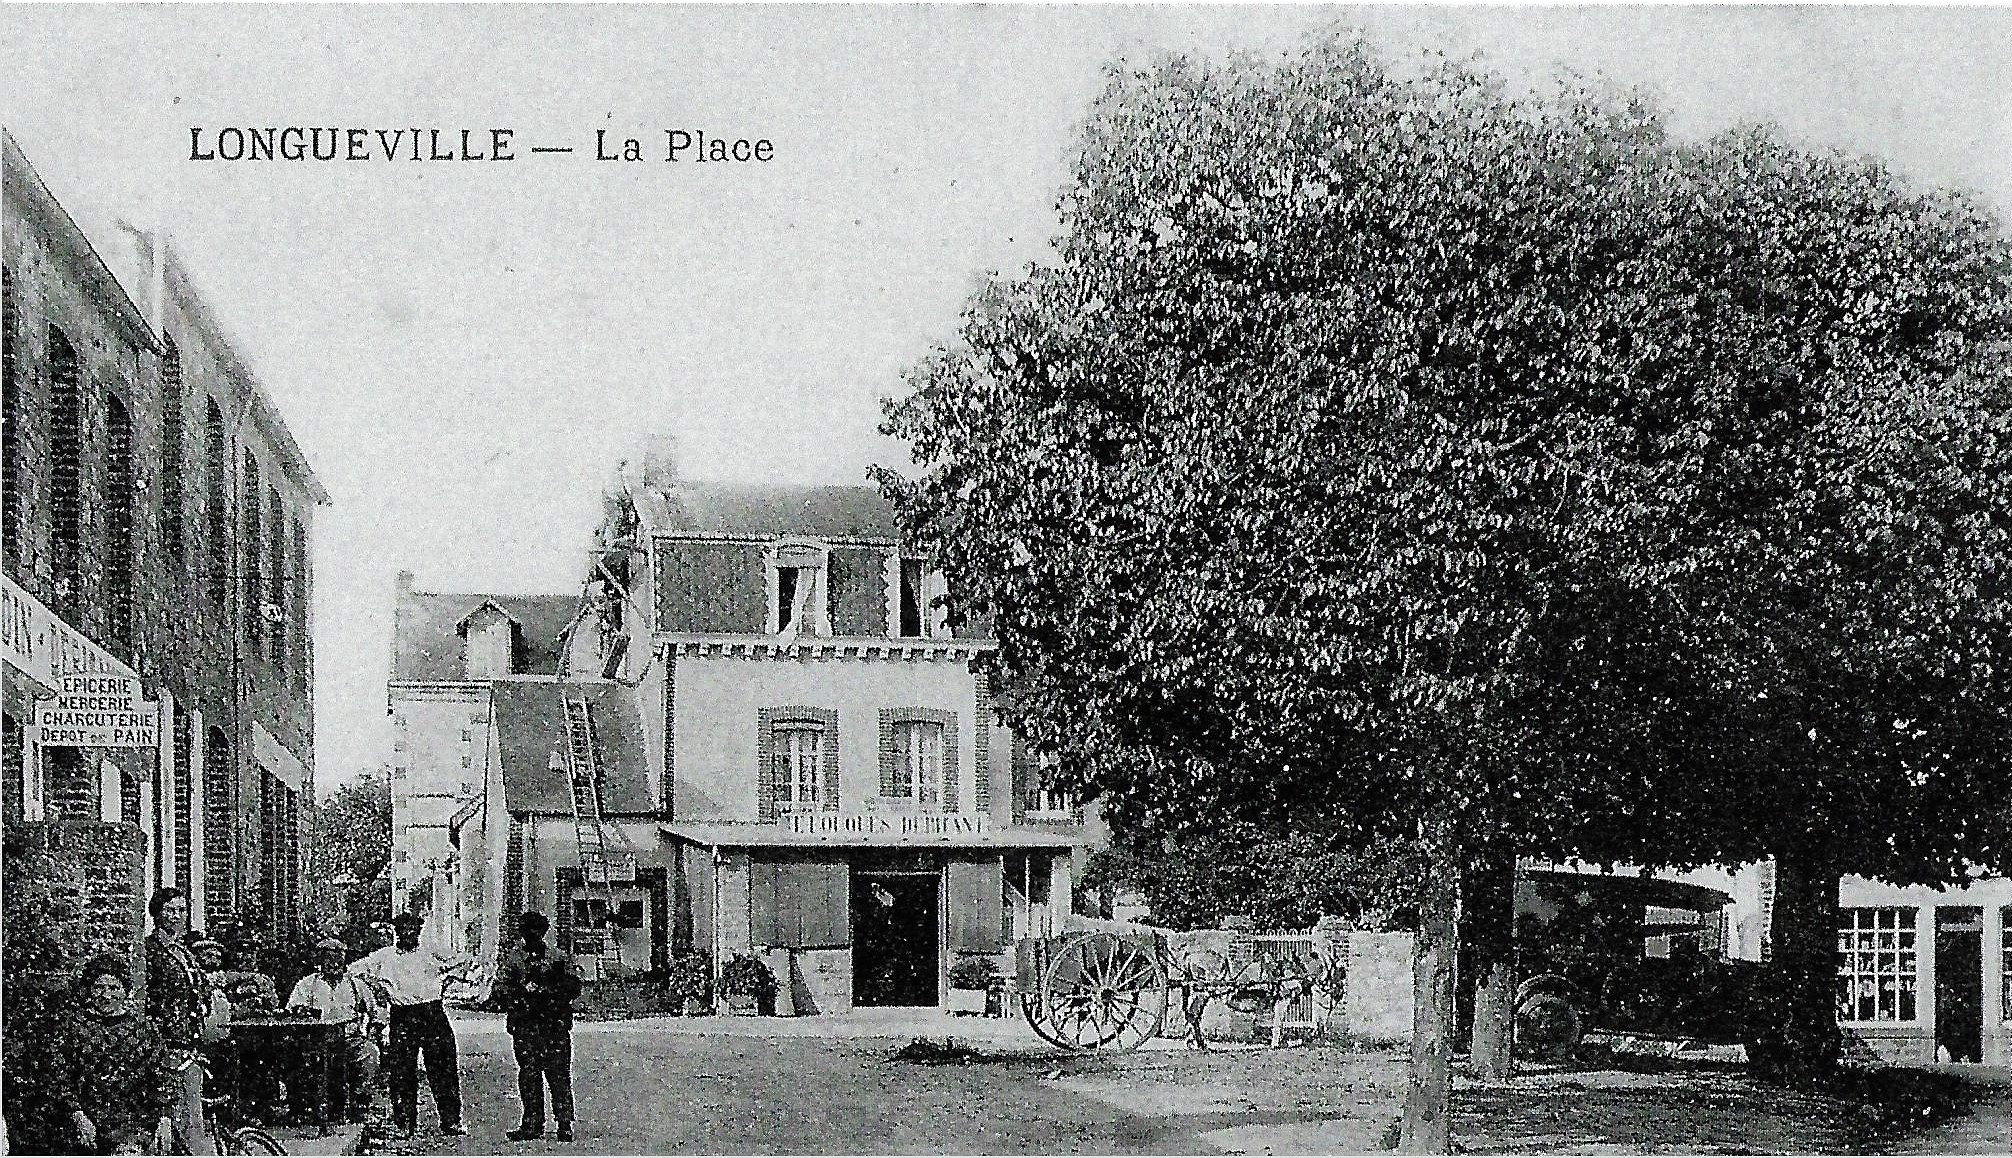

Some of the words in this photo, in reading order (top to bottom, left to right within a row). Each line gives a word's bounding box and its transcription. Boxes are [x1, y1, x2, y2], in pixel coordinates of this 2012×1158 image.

[63, 678, 132, 695] EPICERIE
[58, 696, 133, 711] MERCERIE
[43, 711, 154, 727] CHARCUTERIE
[41, 727, 87, 742] DEPOT
[113, 728, 153, 744] PAIN
